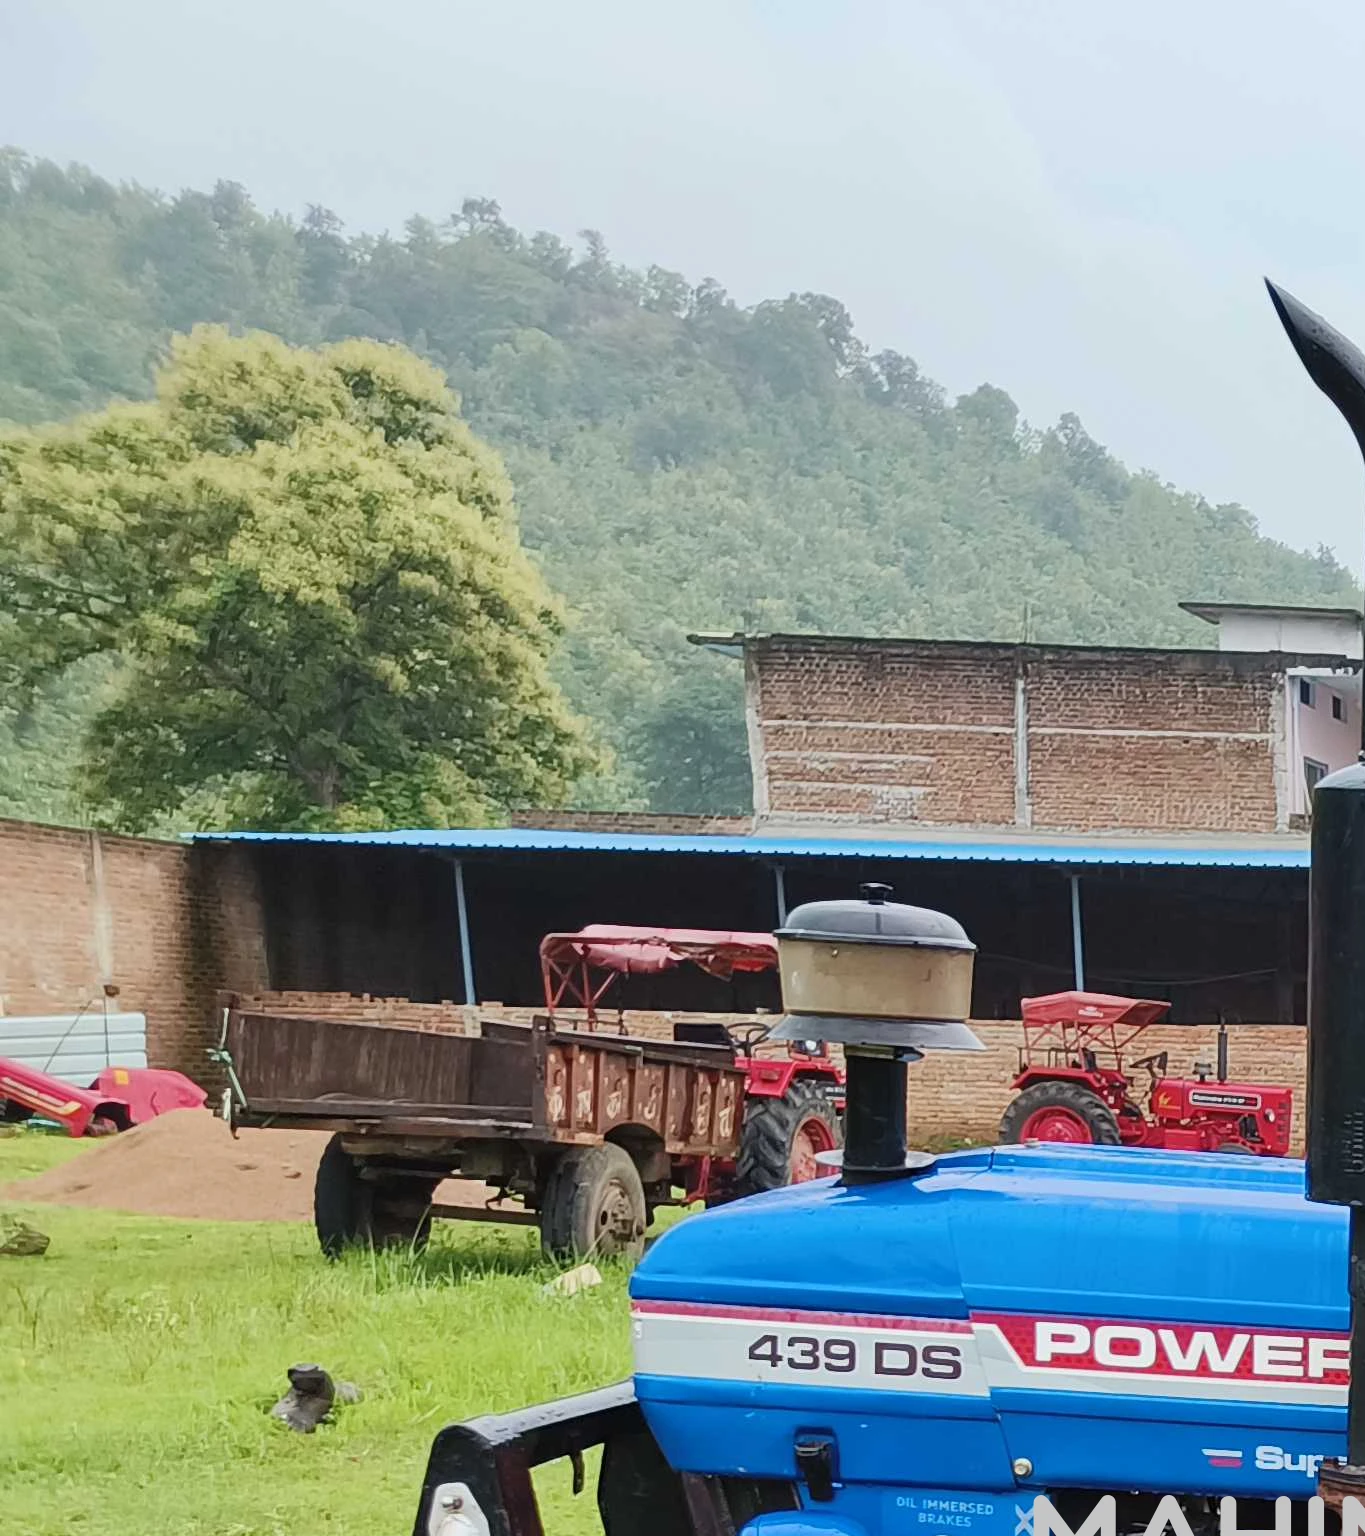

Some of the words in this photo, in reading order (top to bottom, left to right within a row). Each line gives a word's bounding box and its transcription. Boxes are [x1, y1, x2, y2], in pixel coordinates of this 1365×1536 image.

[748, 1334, 856, 1373] 439
[874, 1341, 962, 1380] DS
[896, 1496, 917, 1509] OIL
[922, 1499, 994, 1516] IMMERSED
[917, 1512, 972, 1528] BRAKES
